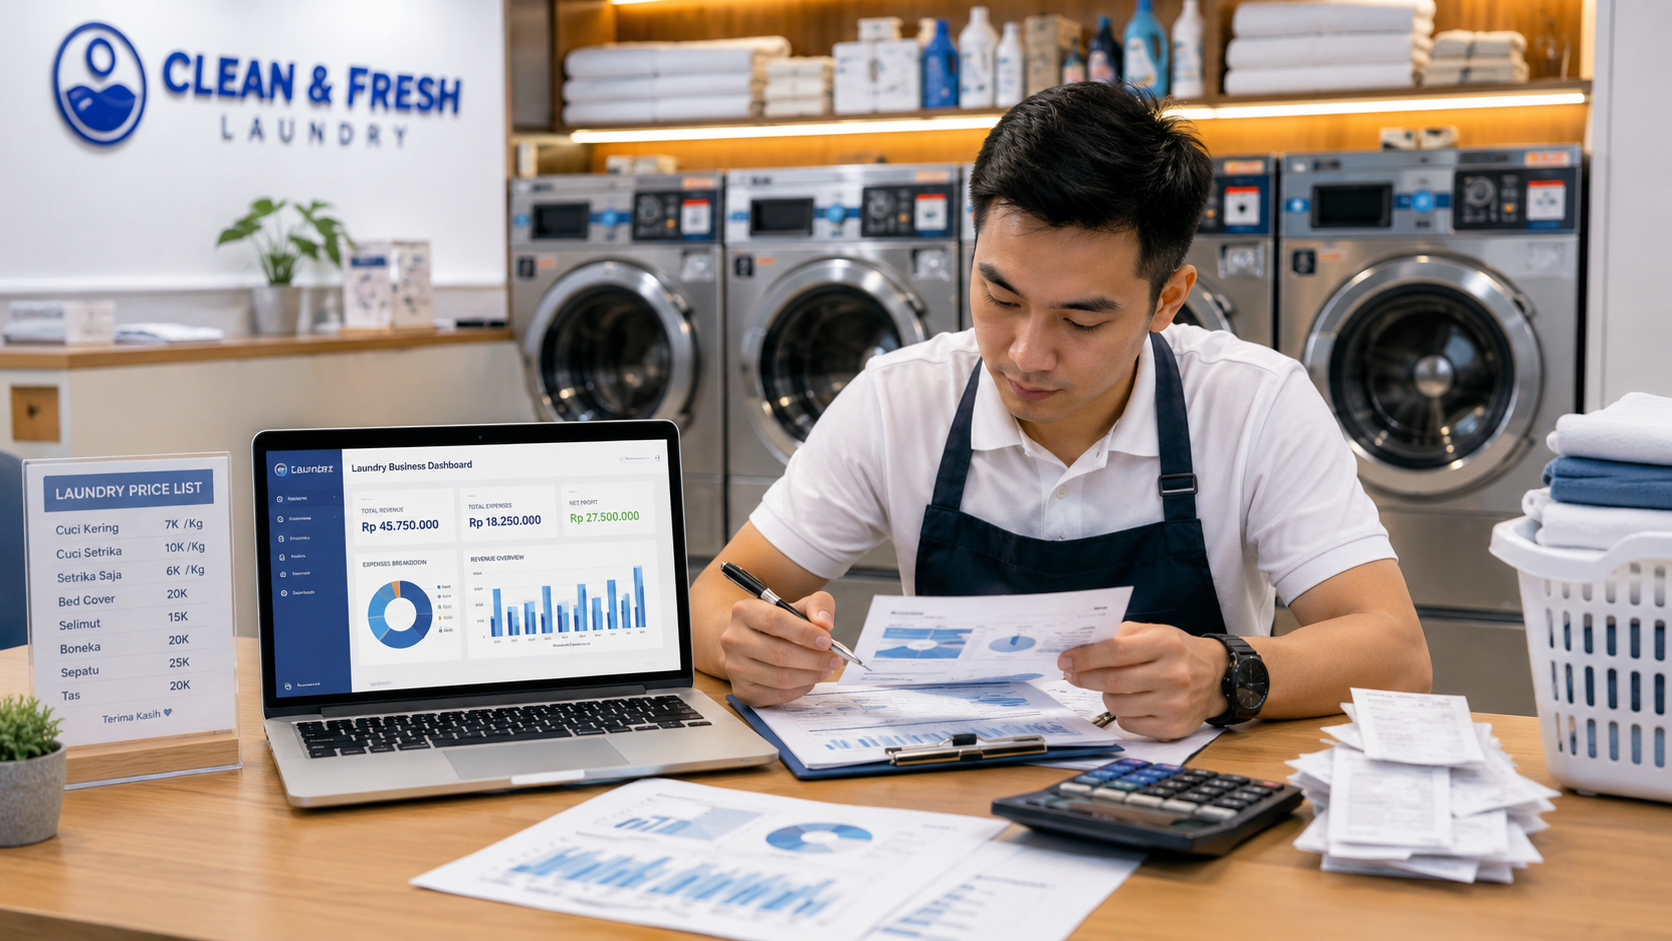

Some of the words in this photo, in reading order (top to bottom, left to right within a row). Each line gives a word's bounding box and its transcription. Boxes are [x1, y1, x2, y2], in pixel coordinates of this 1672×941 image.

[163, 52, 294, 100] CLEAN
[308, 65, 332, 103] &
[347, 67, 461, 114] FRESH
[221, 115, 406, 146] LAUNDRY
[351, 463, 387, 473] Laundry
[389, 462, 426, 471] Business
[428, 460, 472, 470] Dashboard
[55, 485, 125, 500] LAUNDRY
[129, 484, 170, 497] PRICE
[174, 482, 202, 494] LIST
[55, 525, 80, 535] Cuci
[84, 523, 119, 535] Kering
[165, 519, 179, 530] 7K
[183, 519, 203, 530] /Kg
[362, 522, 377, 534] Rp
[379, 519, 439, 531] 45.750.000
[469, 517, 484, 529] Rp
[485, 515, 542, 527] 18.250.000
[570, 513, 584, 525] Rp
[586, 511, 640, 522] 27.500.000
[56, 549, 81, 559] Cuci
[84, 547, 122, 558] Setrika
[165, 542, 184, 552] 10K
[187, 541, 205, 553] /Kg
[57, 572, 96, 583] Setrika
[99, 571, 122, 582] Saja
[166, 566, 181, 576] 6K
[185, 564, 205, 576] /Kg
[58, 597, 80, 607] Bed
[83, 594, 115, 605] Cover
[167, 589, 187, 599] 20K
[59, 619, 101, 630] Selimut
[168, 612, 188, 622] 15K
[60, 643, 101, 654] Boneka
[168, 635, 189, 645] 20K
[61, 666, 99, 679] Sepatu
[169, 657, 189, 668] 25K
[61, 691, 80, 701] Tas
[170, 680, 190, 691] 20K
[102, 713, 134, 723] Terima
[136, 710, 161, 721] Kasih
